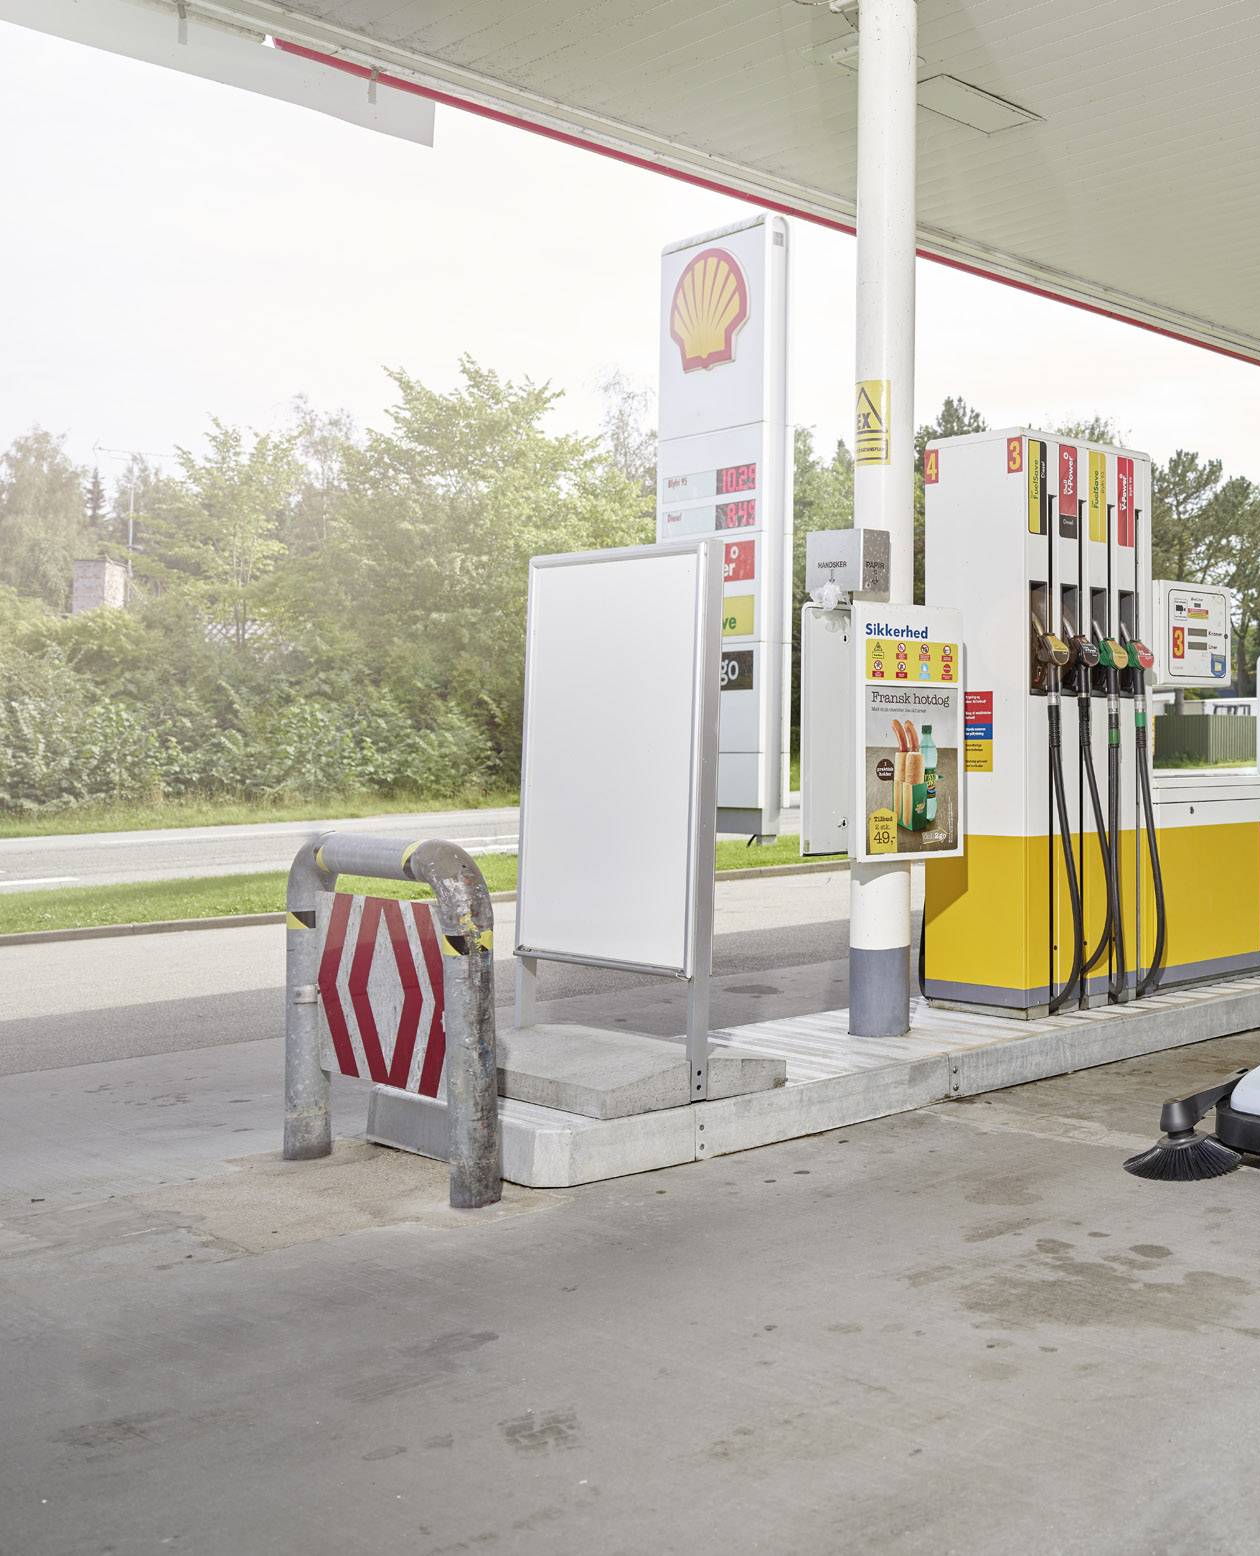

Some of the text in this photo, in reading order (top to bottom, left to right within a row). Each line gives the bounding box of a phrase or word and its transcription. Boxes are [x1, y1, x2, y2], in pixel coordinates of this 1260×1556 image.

[857, 412, 871, 430] EX
[1009, 441, 1020, 470] 3
[926, 453, 936, 481] 4
[817, 560, 848, 569] HANDSKER
[865, 561, 885, 569] PAPIR
[865, 623, 929, 639] Sikkerhed
[1174, 629, 1184, 656] 3
[871, 691, 911, 705] Fransk
[913, 693, 950, 708] hotdog
